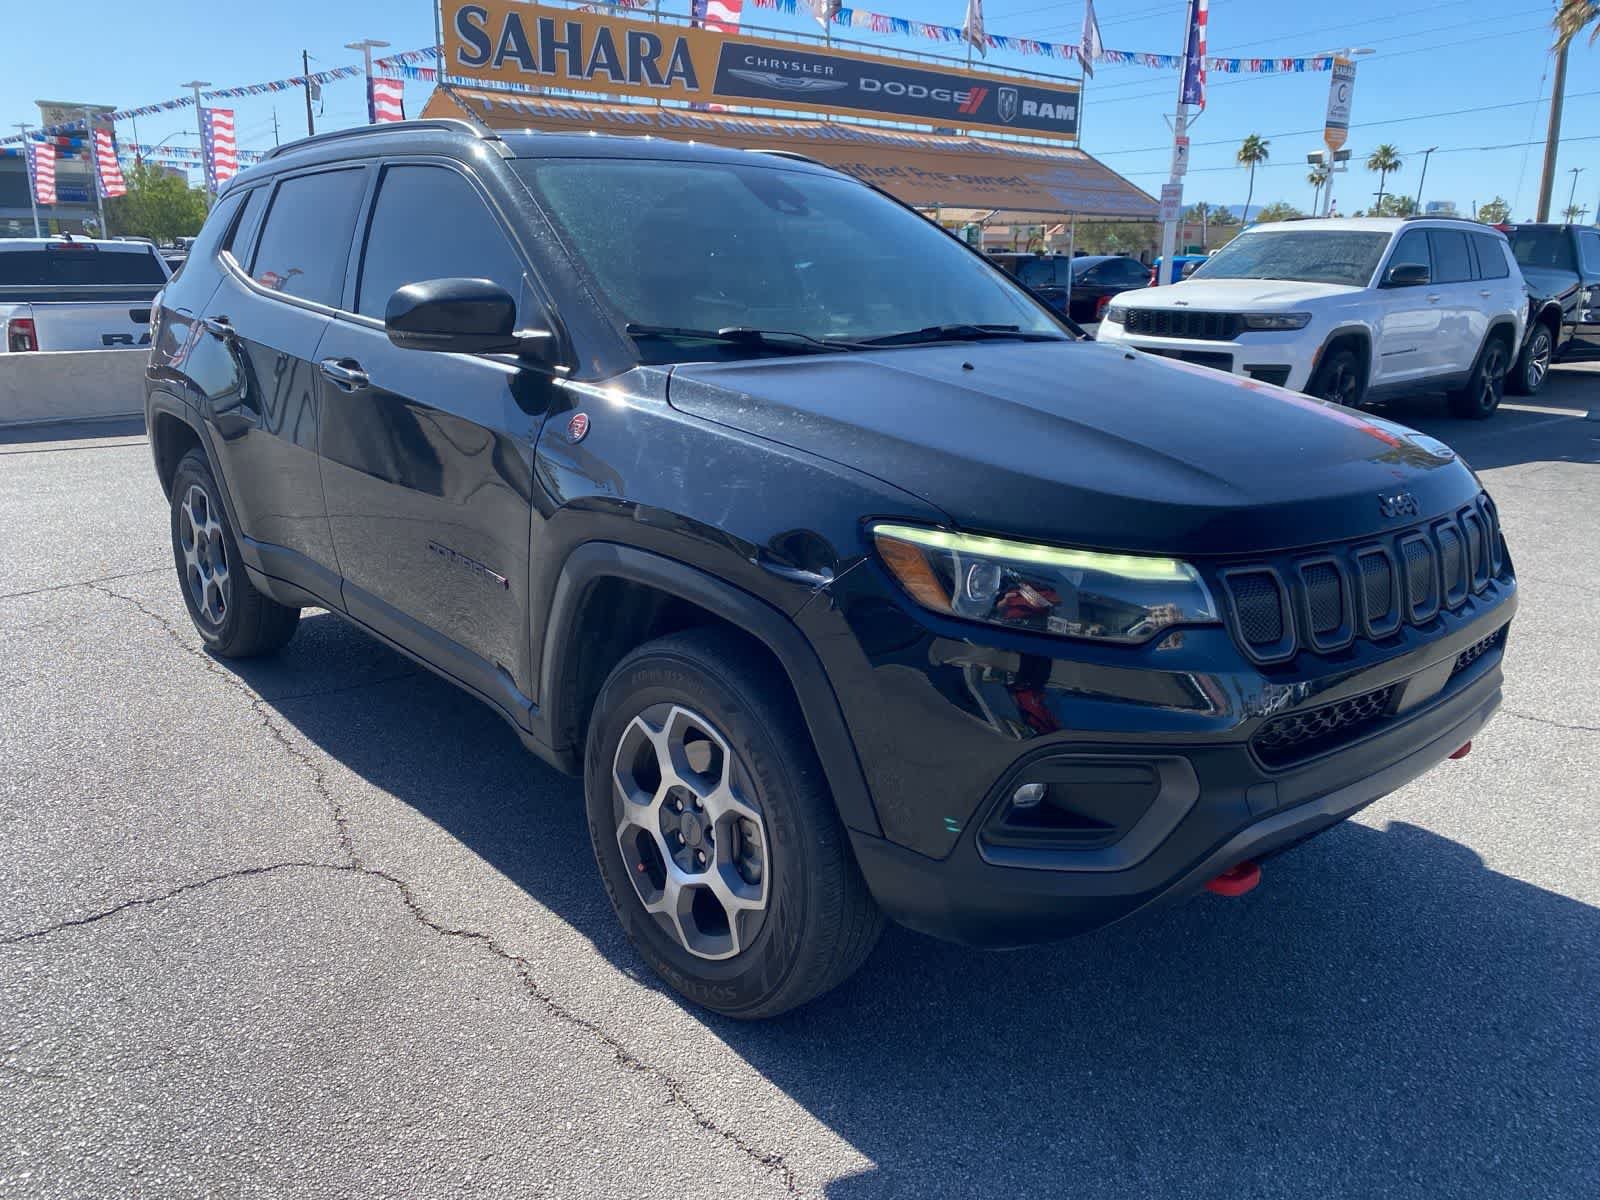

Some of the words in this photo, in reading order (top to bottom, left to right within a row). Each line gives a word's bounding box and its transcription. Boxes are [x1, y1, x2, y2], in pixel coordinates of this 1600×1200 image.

[455, 5, 700, 91] SAHARA
[744, 55, 835, 75] CHRYSLER
[858, 77, 972, 105] DODGE
[1021, 100, 1075, 121] RAM
